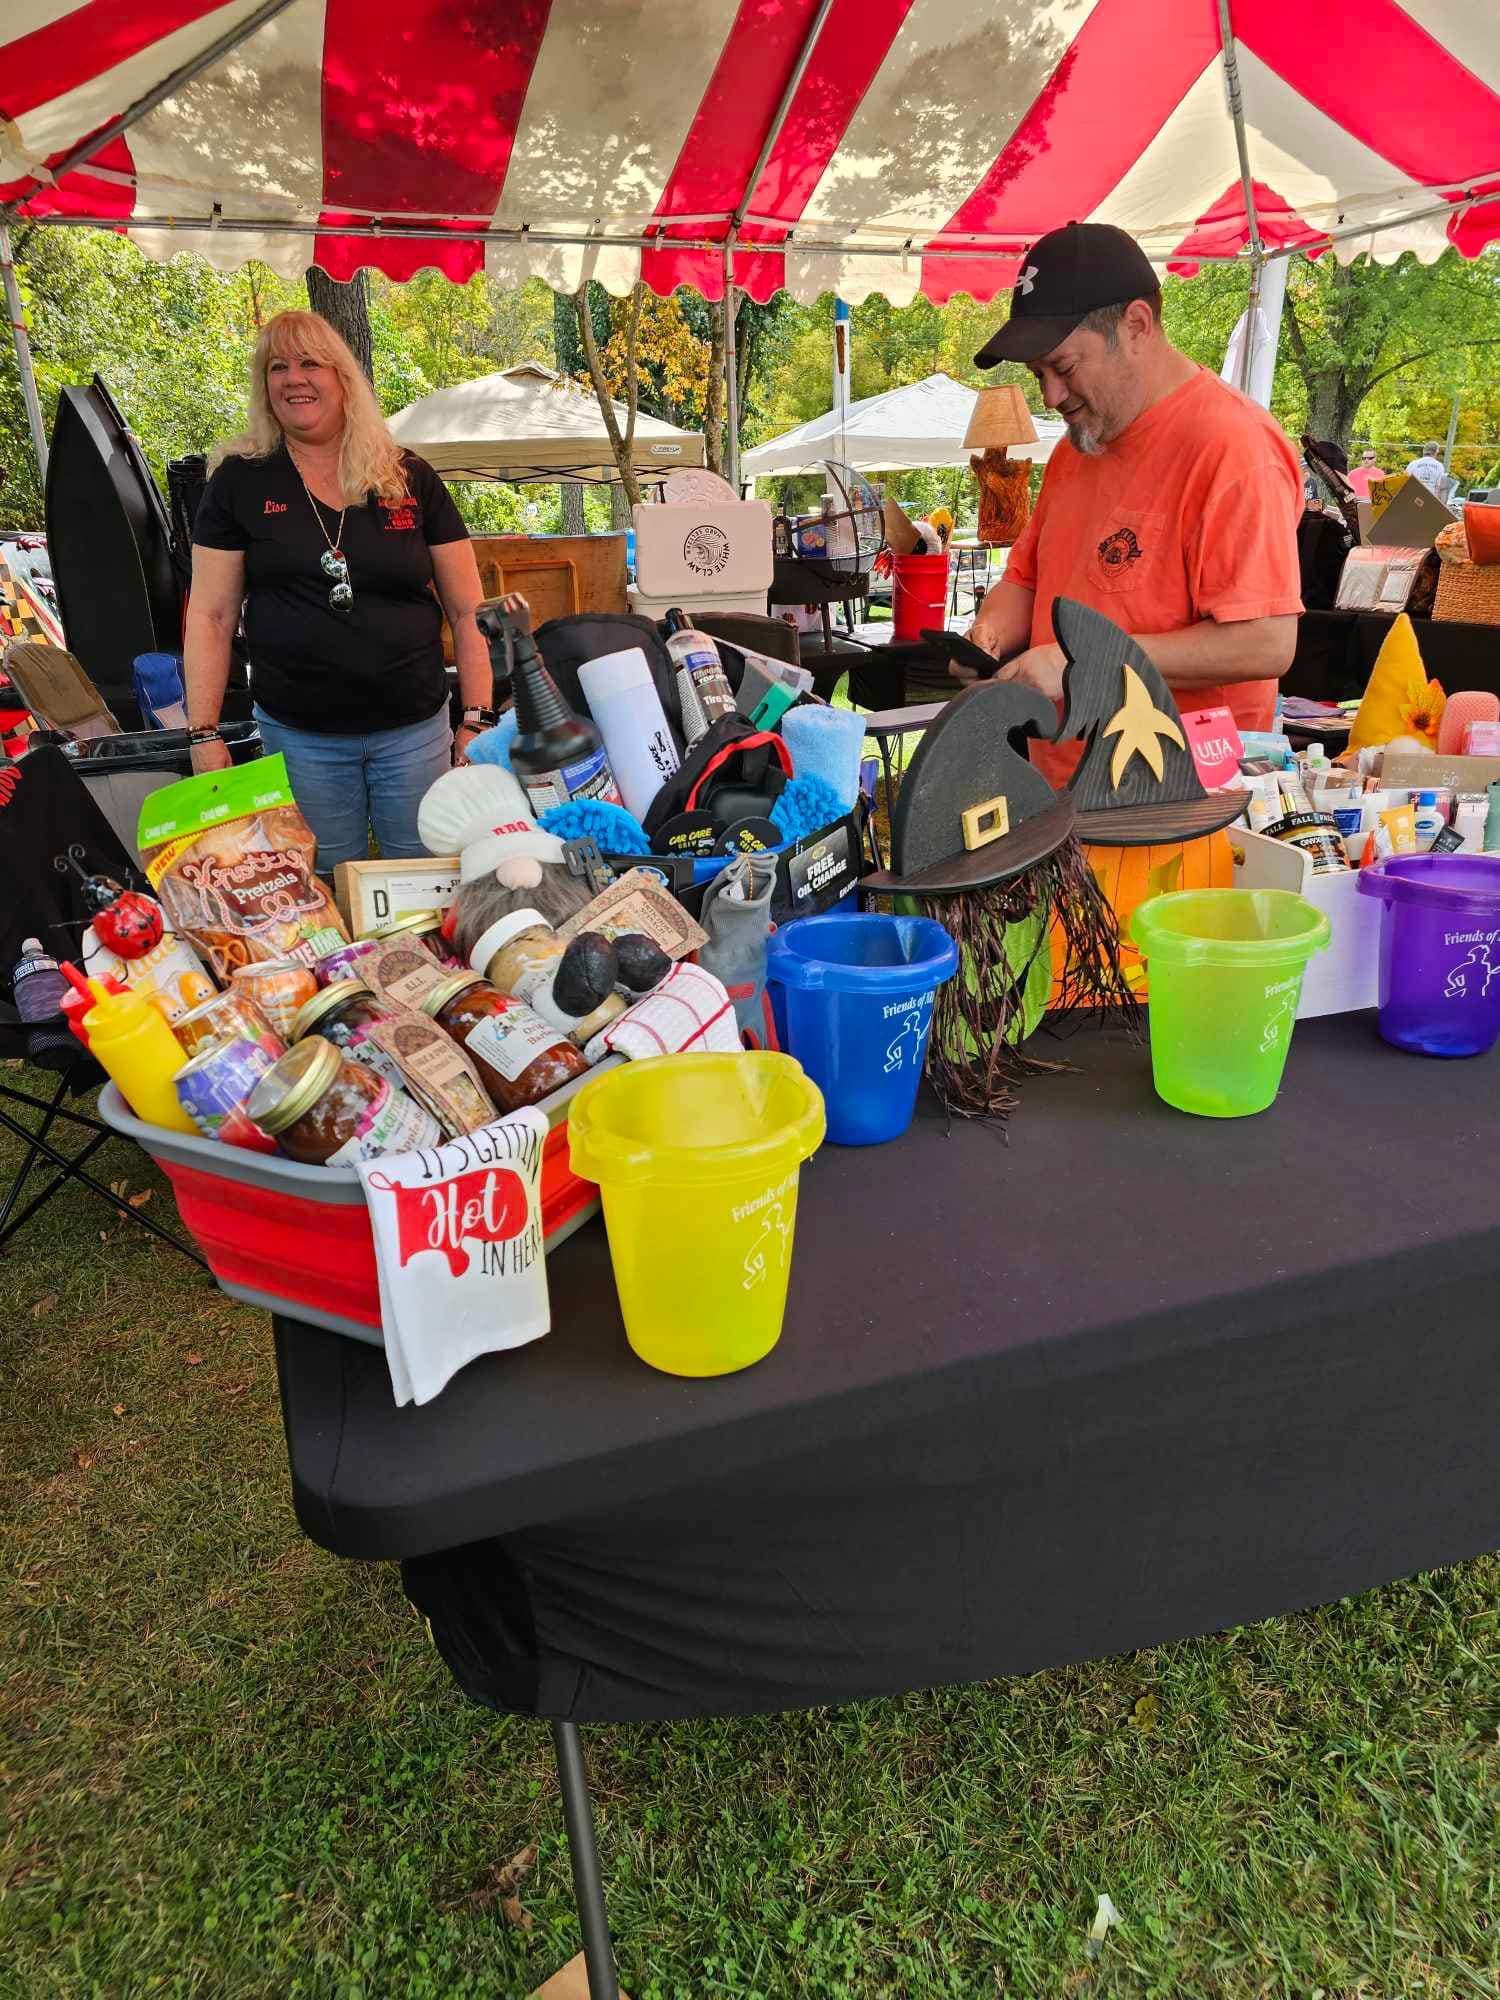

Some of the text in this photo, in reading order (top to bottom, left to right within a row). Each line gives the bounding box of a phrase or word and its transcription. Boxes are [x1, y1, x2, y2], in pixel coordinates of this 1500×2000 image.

[263, 500, 288, 514] Lisa
[687, 542, 730, 577] WHITE CLAW
[703, 694, 721, 706] Tire
[1196, 738, 1233, 759] ULTA
[1291, 814, 1313, 826] FALL
[668, 827, 713, 846] CAR CARE
[153, 847, 177, 875] NEW
[807, 852, 835, 880] FREE
[232, 872, 299, 905] Pretzels
[797, 859, 848, 899] OIL CHANGE
[1444, 930, 1500, 946] Friends of
[883, 997, 917, 1019] Friends
[917, 992, 928, 1010] of
[422, 1171, 508, 1249] Hot
[731, 1186, 776, 1223] Friends
[481, 1240, 505, 1277] IN
